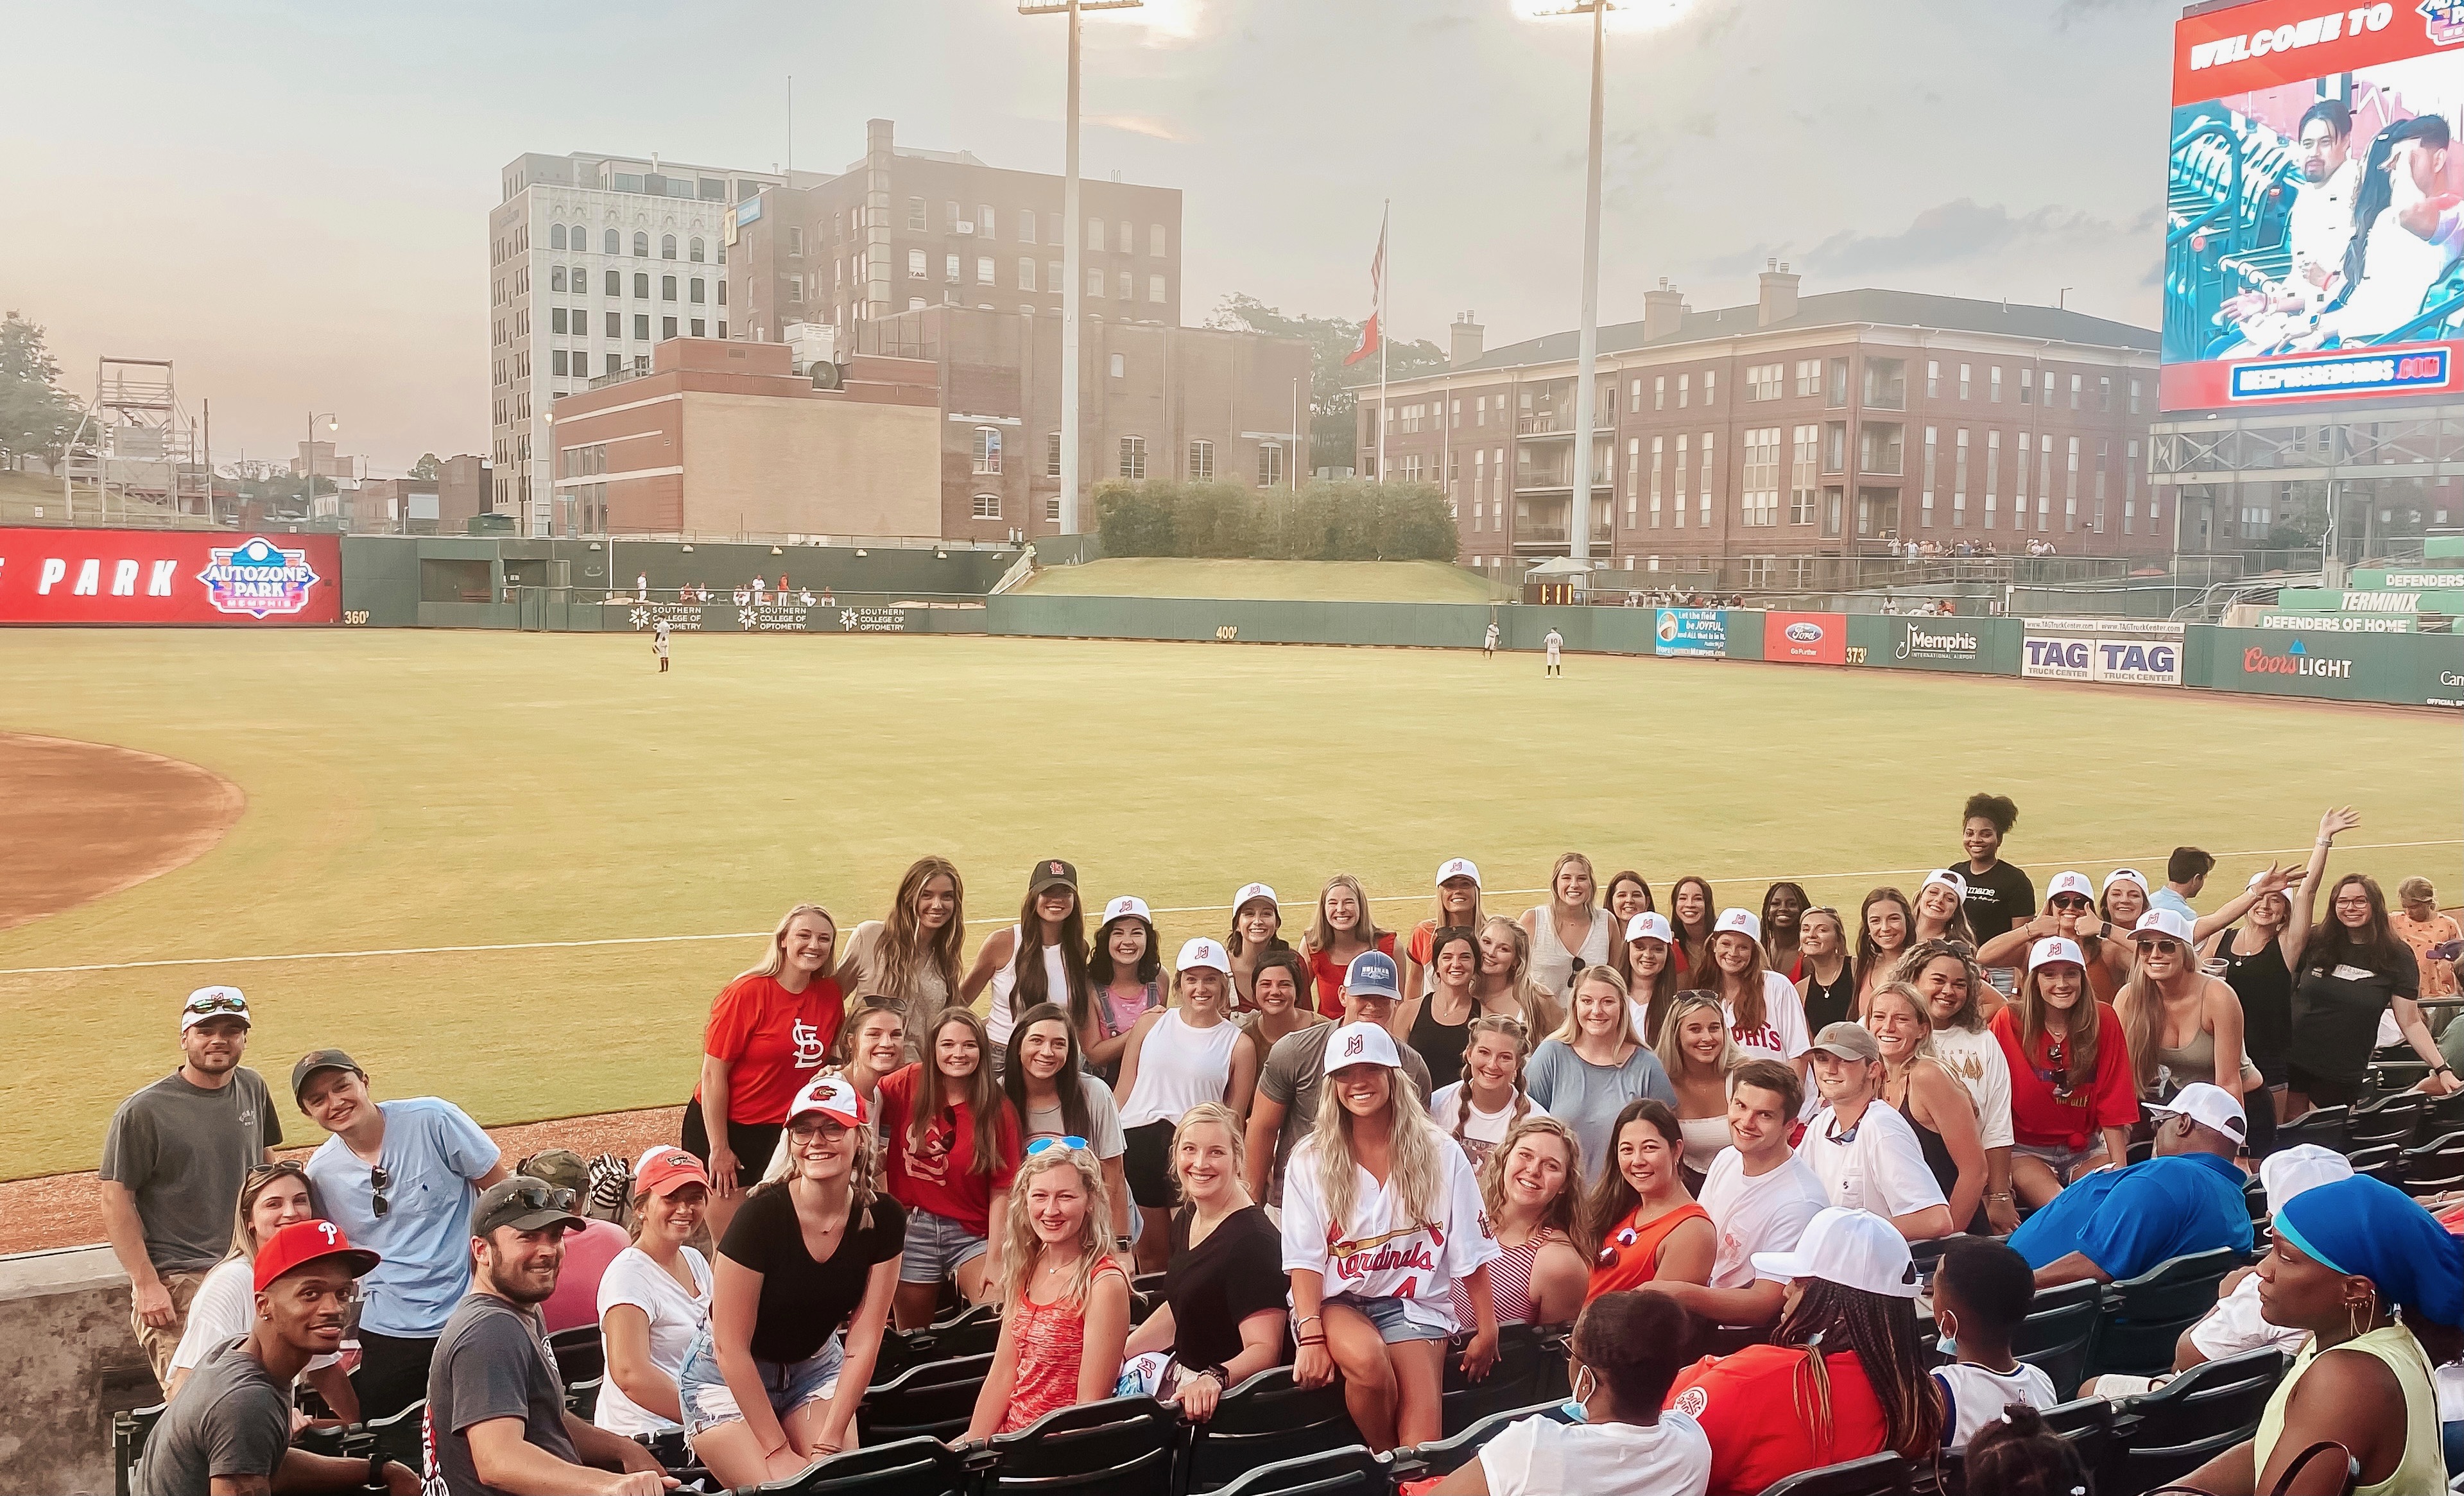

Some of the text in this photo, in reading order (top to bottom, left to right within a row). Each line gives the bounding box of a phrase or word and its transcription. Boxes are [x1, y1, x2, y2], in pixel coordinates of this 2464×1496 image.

[2191, 2, 2393, 71] WELCOME TO
[37, 557, 178, 597] PARK
[207, 565, 309, 582] AUTOZONE
[2386, 574, 2464, 588] DEFENDERS
[234, 581, 285, 598] PARK
[227, 599, 292, 607] MEMPHIS
[2341, 592, 2422, 612] TERMINIX
[344, 610, 370, 624] 360'
[1678, 611, 1717, 621] Let the field
[2262, 615, 2340, 631] DEFENDERS
[2342, 617, 2364, 632] OF
[1216, 626, 1237, 639] 400'
[1685, 620, 1725, 633] be JOYFUL,
[1792, 625, 1817, 641] Ford
[2026, 621, 2094, 630] www.TAGTruckCenter.com
[2101, 623, 2180, 632] www.TAGTruckCenter.com
[1912, 631, 1977, 653] Memphis
[1846, 646, 1868, 664] 373'
[2025, 641, 2089, 669] TAG
[2099, 644, 2175, 673] TAG
[2243, 645, 2352, 678] Coors LIGHT
[2028, 667, 2088, 678] TRUCK CENTER
[2103, 672, 2175, 682] TRUCK CENTER
[318, 1221, 338, 1245] P
[1337, 1241, 1435, 1280] Cardinals
